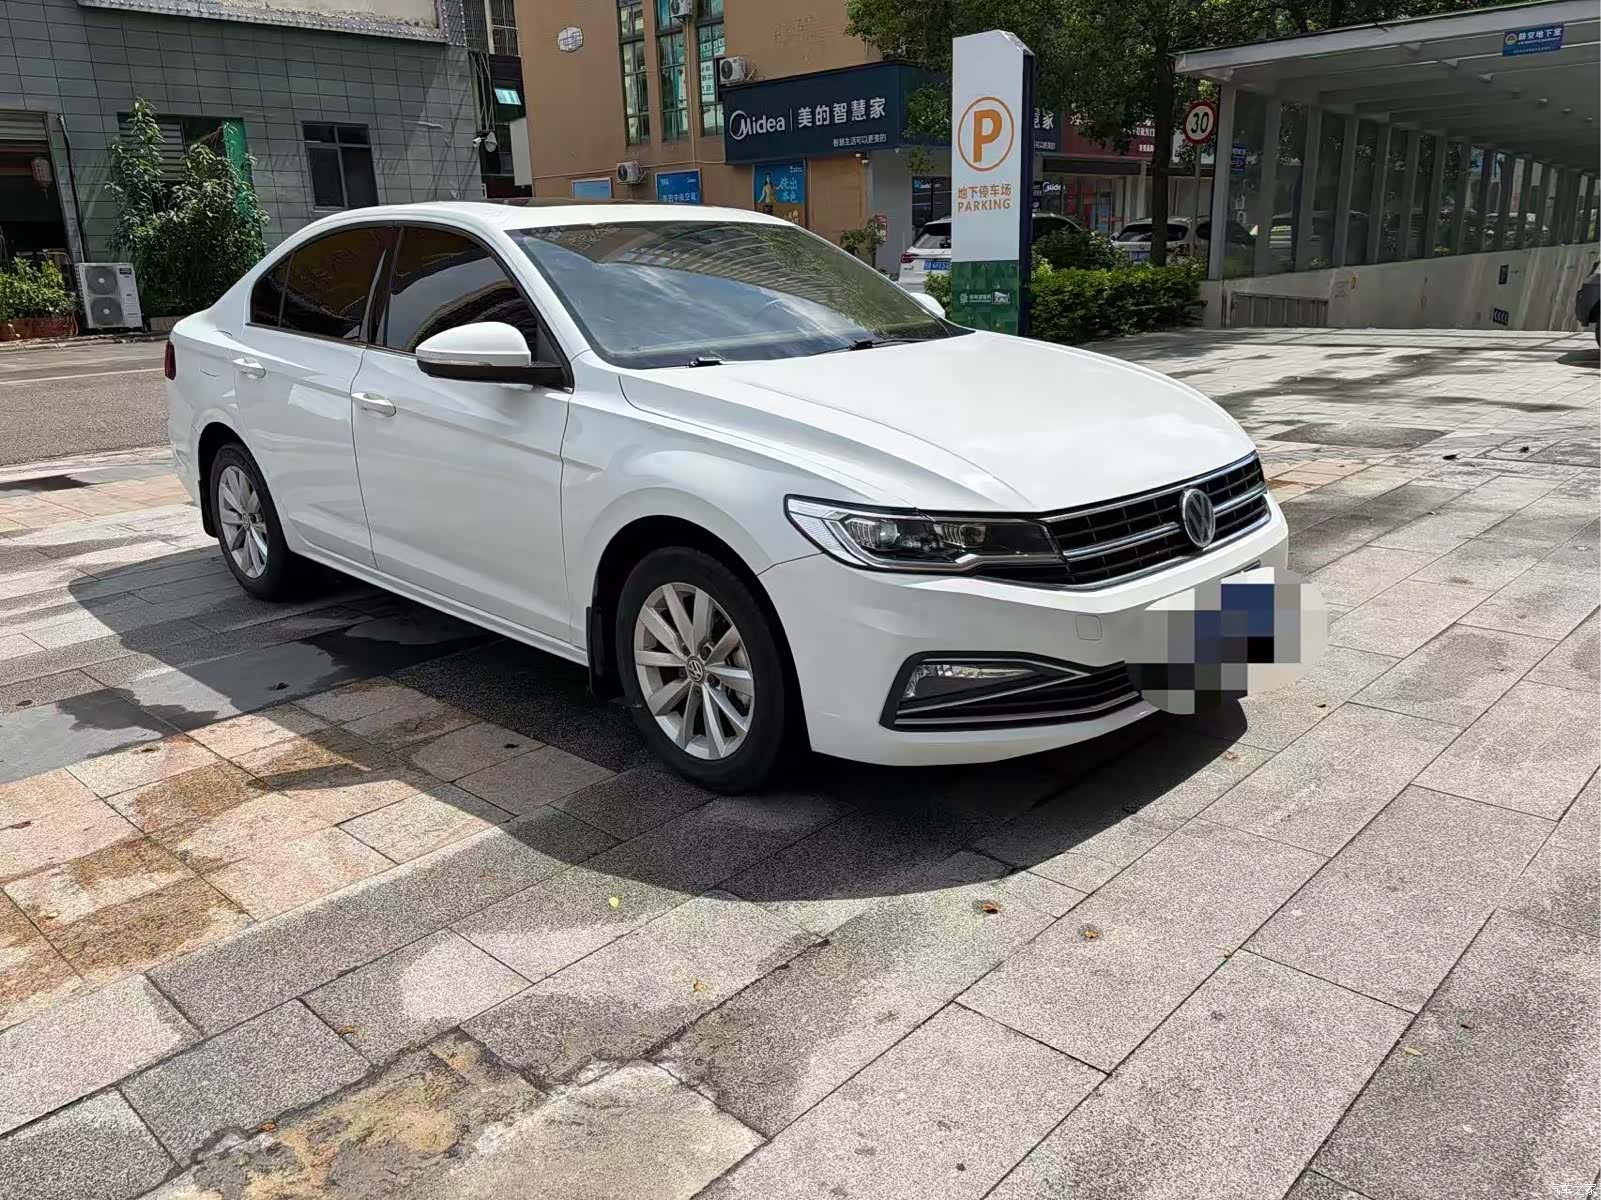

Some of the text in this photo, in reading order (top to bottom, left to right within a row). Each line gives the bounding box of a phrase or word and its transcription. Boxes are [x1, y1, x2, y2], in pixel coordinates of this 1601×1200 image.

[1518, 27, 1562, 41] 防空地下室
[798, 96, 886, 128] 美的智慧家
[729, 110, 785, 140] Midea
[1190, 111, 1209, 134] 30
[833, 133, 887, 147] 智慧生活可以更美的
[957, 183, 1012, 200] 地下停车场
[957, 199, 1011, 213] PARKING
